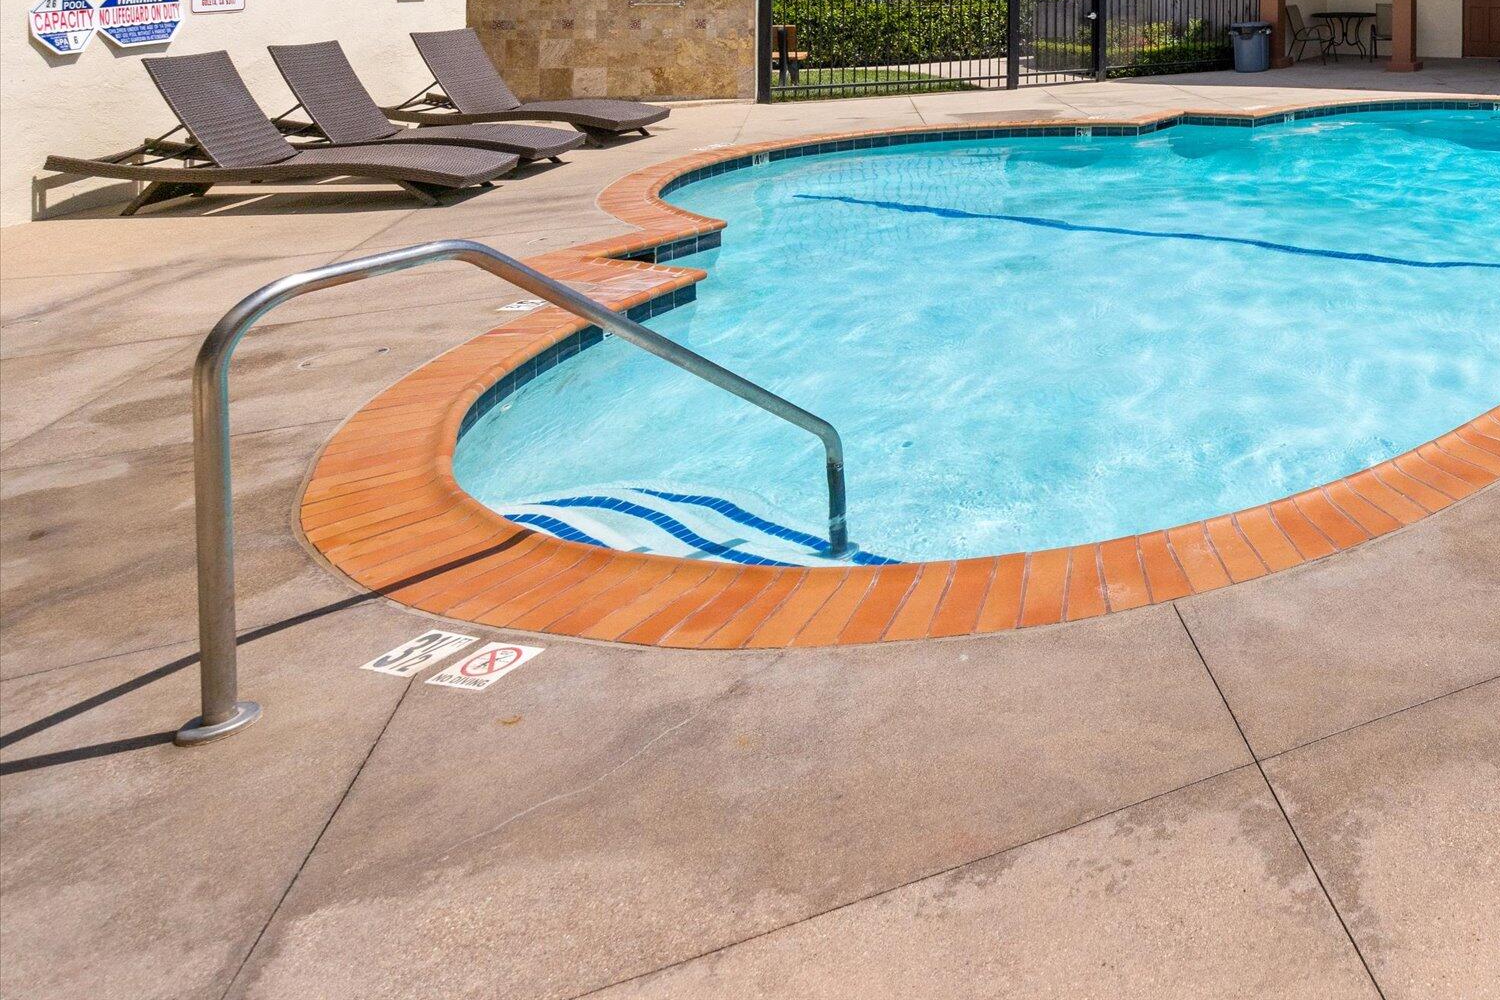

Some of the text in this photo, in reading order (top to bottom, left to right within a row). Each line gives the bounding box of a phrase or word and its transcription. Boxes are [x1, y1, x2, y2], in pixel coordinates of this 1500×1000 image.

[64, 0, 87, 9] POOL
[34, 9, 94, 31] CAPACITY
[99, 3, 180, 26] NO LIFEGUARD ON DUTY
[54, 38, 69, 47] SPA
[431, 673, 490, 688] NO DIVING
